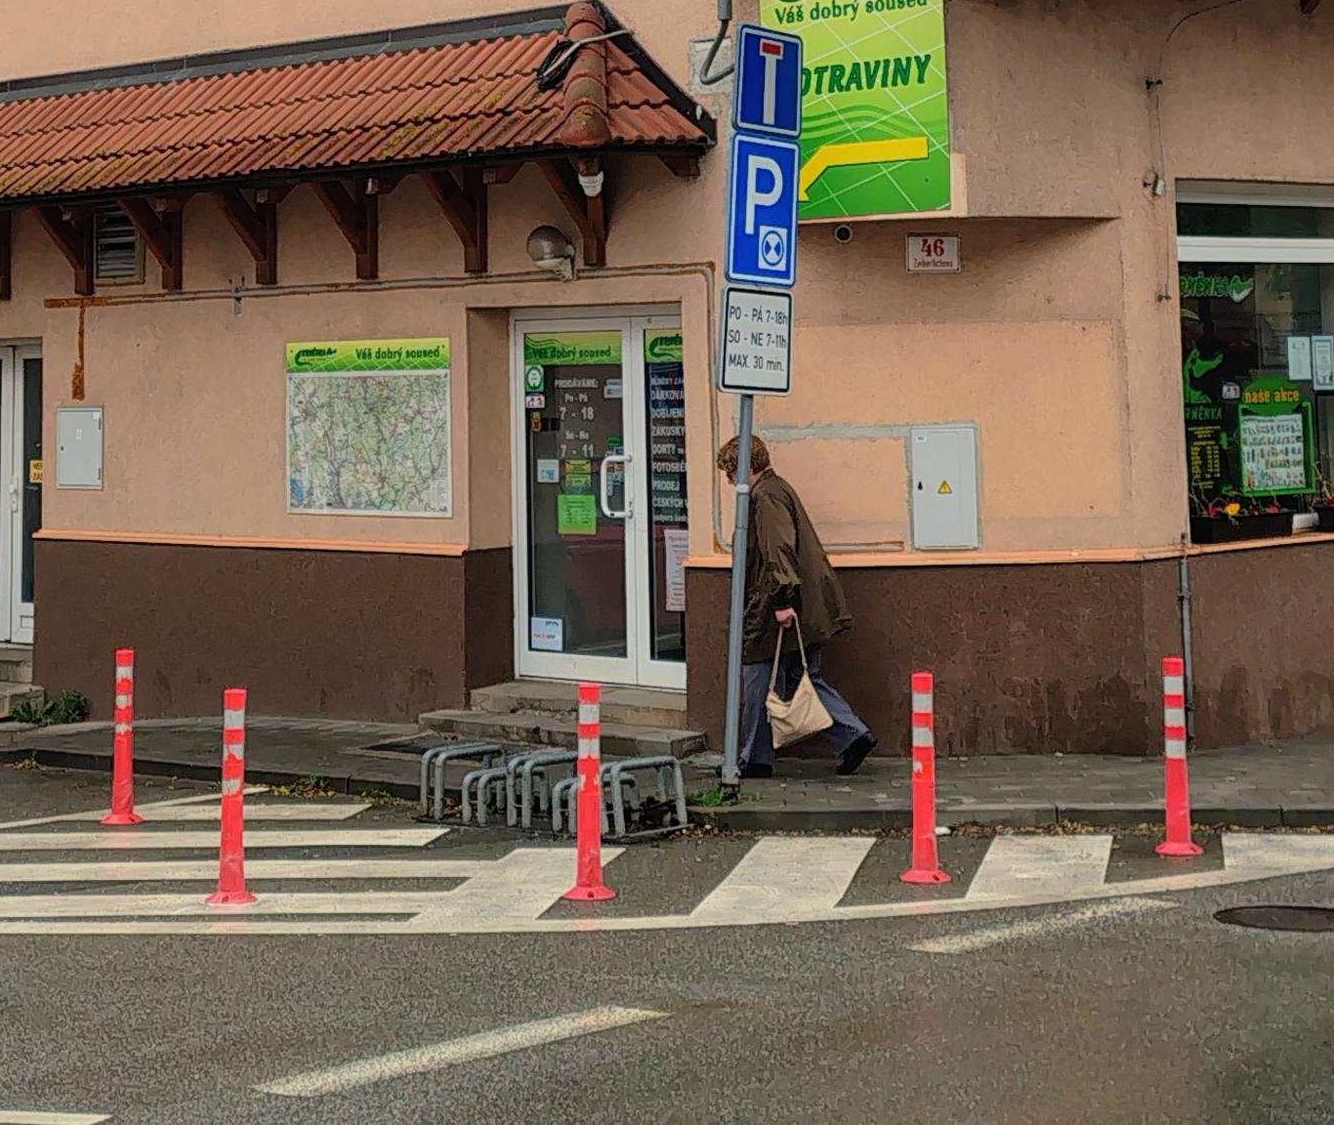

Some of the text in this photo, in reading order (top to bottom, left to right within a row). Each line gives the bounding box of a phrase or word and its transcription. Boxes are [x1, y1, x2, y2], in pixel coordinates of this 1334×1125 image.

[775, 5, 804, 25] Váš
[801, 54, 931, 97] OTRAVINY
[745, 154, 784, 235] P
[921, 238, 944, 257] 46
[729, 306, 742, 320] PO
[751, 305, 763, 323] PÁ
[728, 330, 740, 344] SO
[751, 332, 763, 346] NE
[355, 347, 372, 360] Váš
[375, 346, 403, 363] dobrý
[406, 346, 440, 359] soused
[551, 346, 576, 361] dobrý
[579, 345, 611, 358] soused
[728, 354, 784, 371] MAX. 30 min.
[1243, 384, 1300, 404] naše akce
[559, 407, 567, 420] 7
[581, 406, 594, 420] 18
[1185, 405, 1223, 421] RNĚNKA
[560, 444, 567, 457] 7
[582, 443, 594, 457] 11
